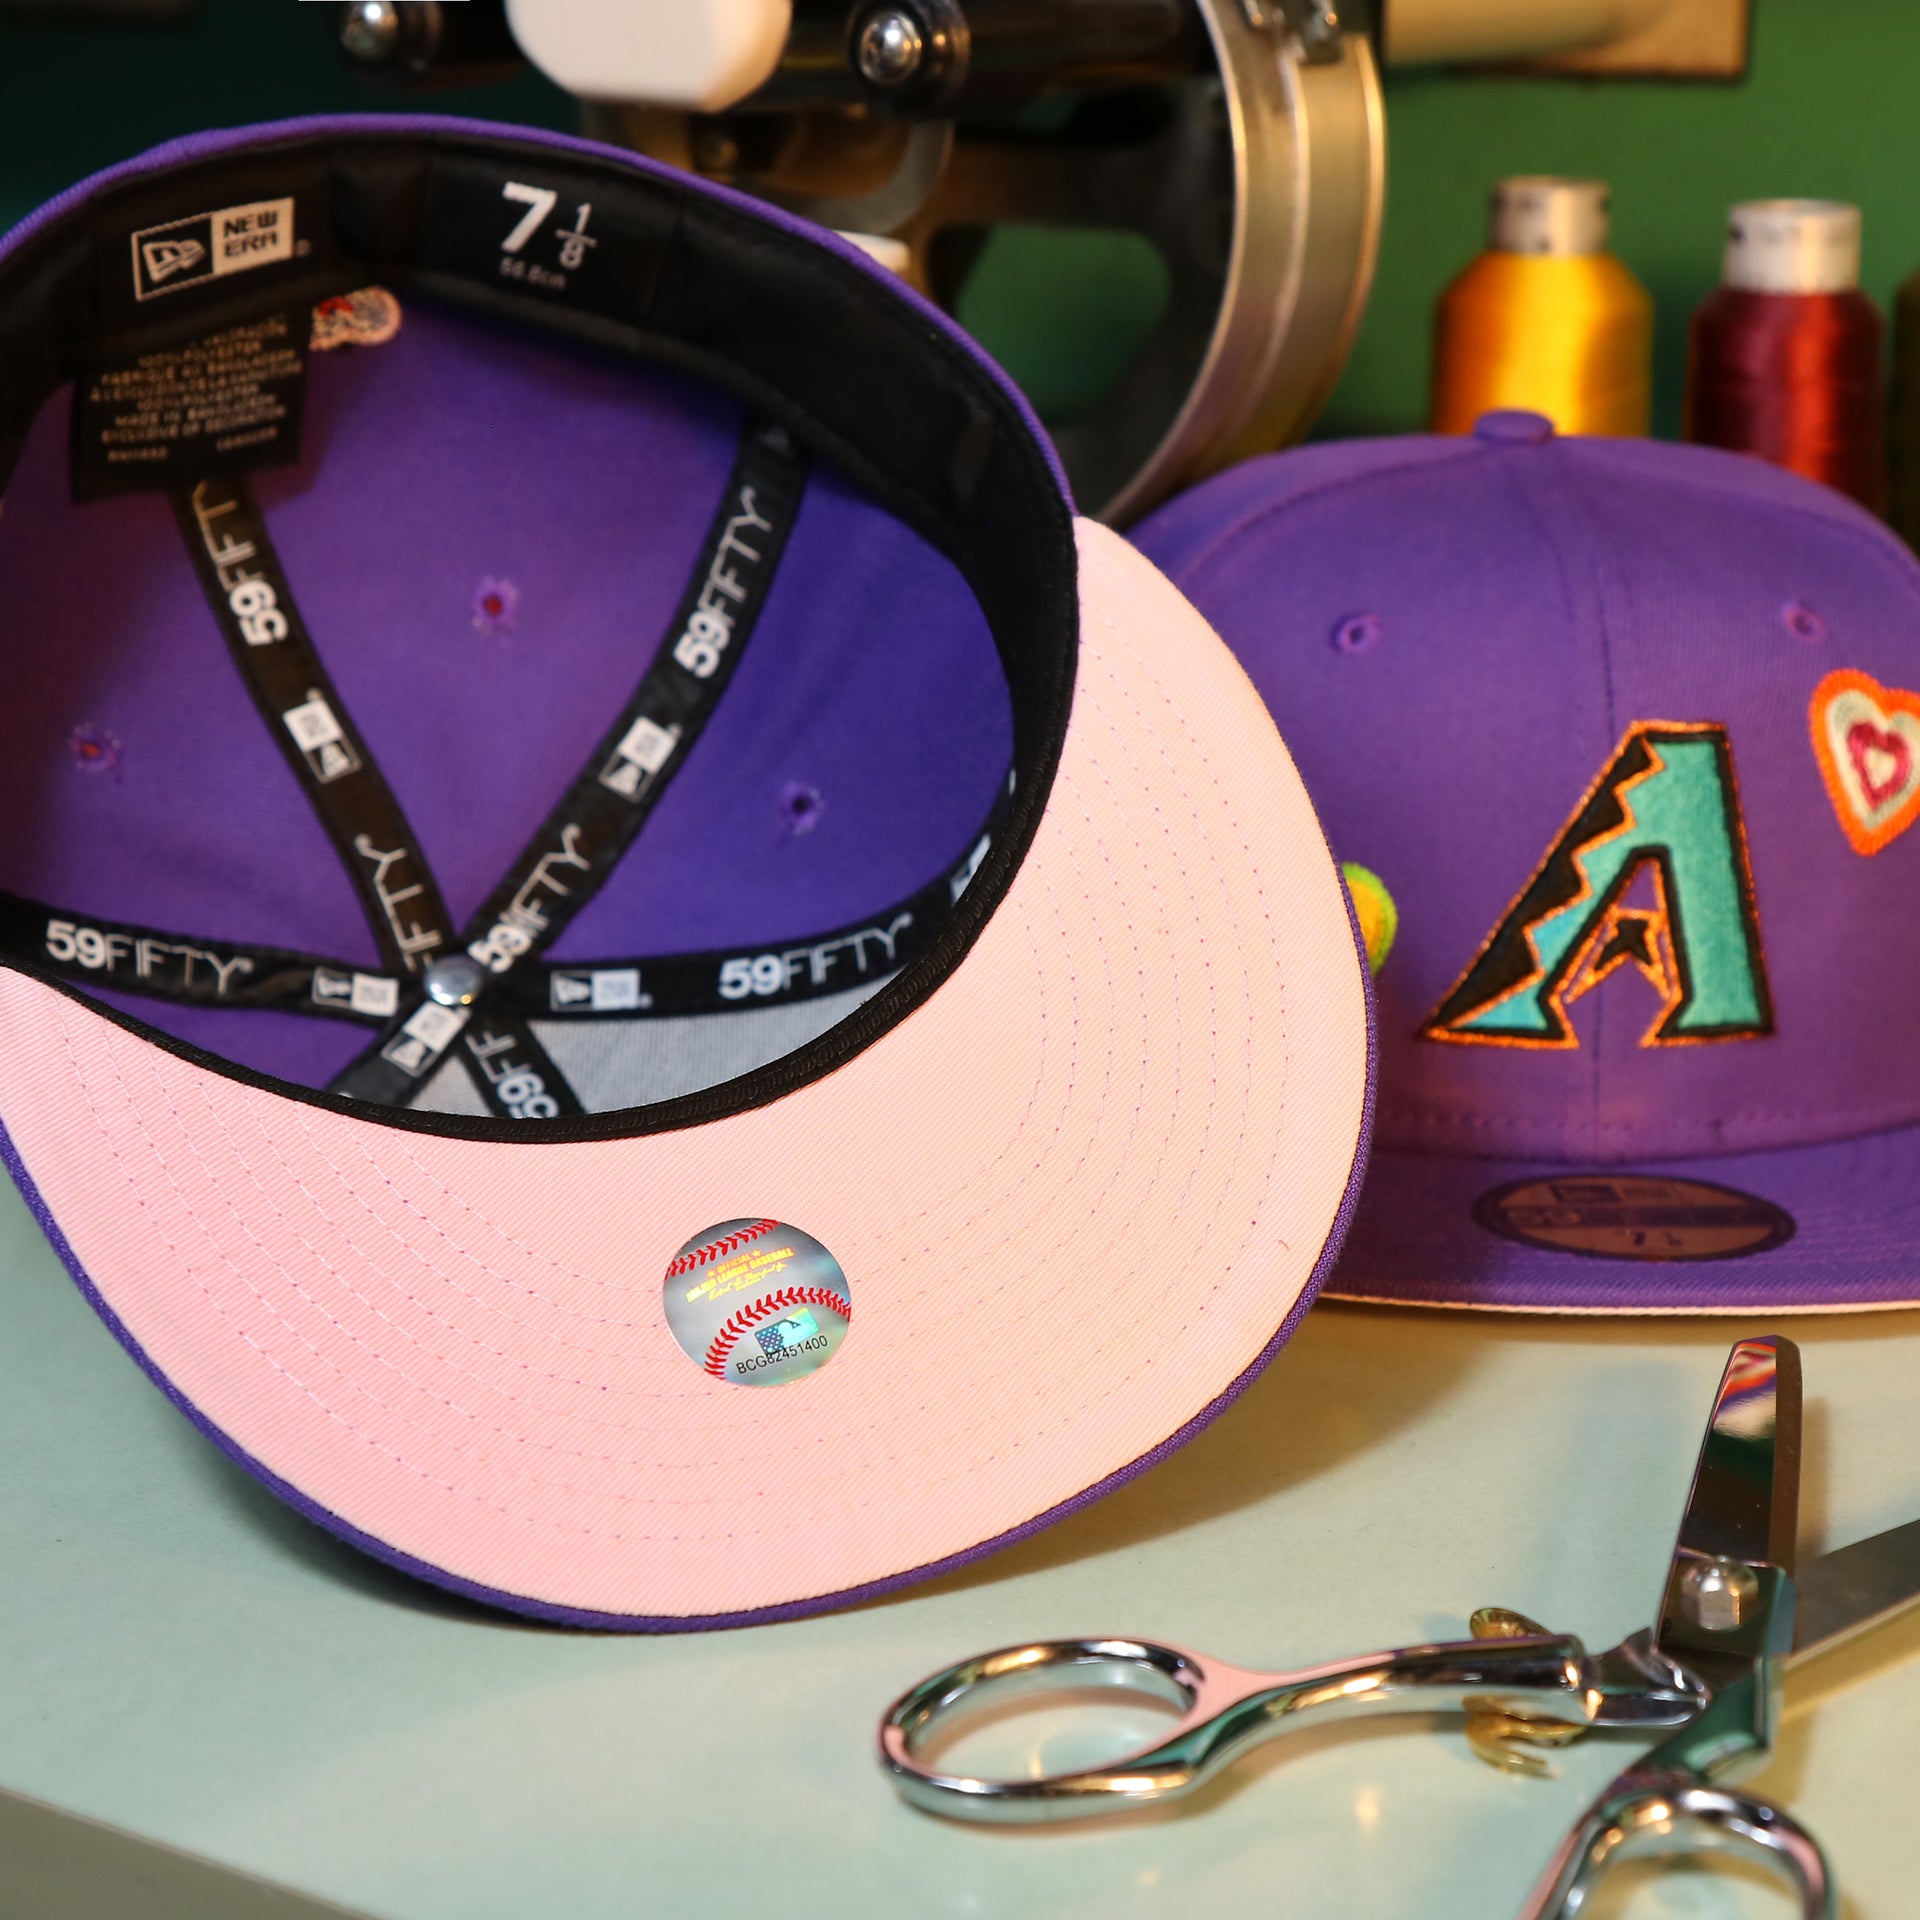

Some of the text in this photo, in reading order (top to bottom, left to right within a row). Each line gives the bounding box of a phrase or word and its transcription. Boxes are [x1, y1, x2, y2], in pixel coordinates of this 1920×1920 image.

[223, 209, 280, 238] NEW
[502, 180, 557, 253] 7
[223, 231, 279, 258] ERA
[45, 919, 255, 995] 59FIFTY
[718, 912, 914, 999] 59FIFTY
[749, 1247, 796, 1270] BASEBALL
[736, 1335, 828, 1374] BCG82451400
